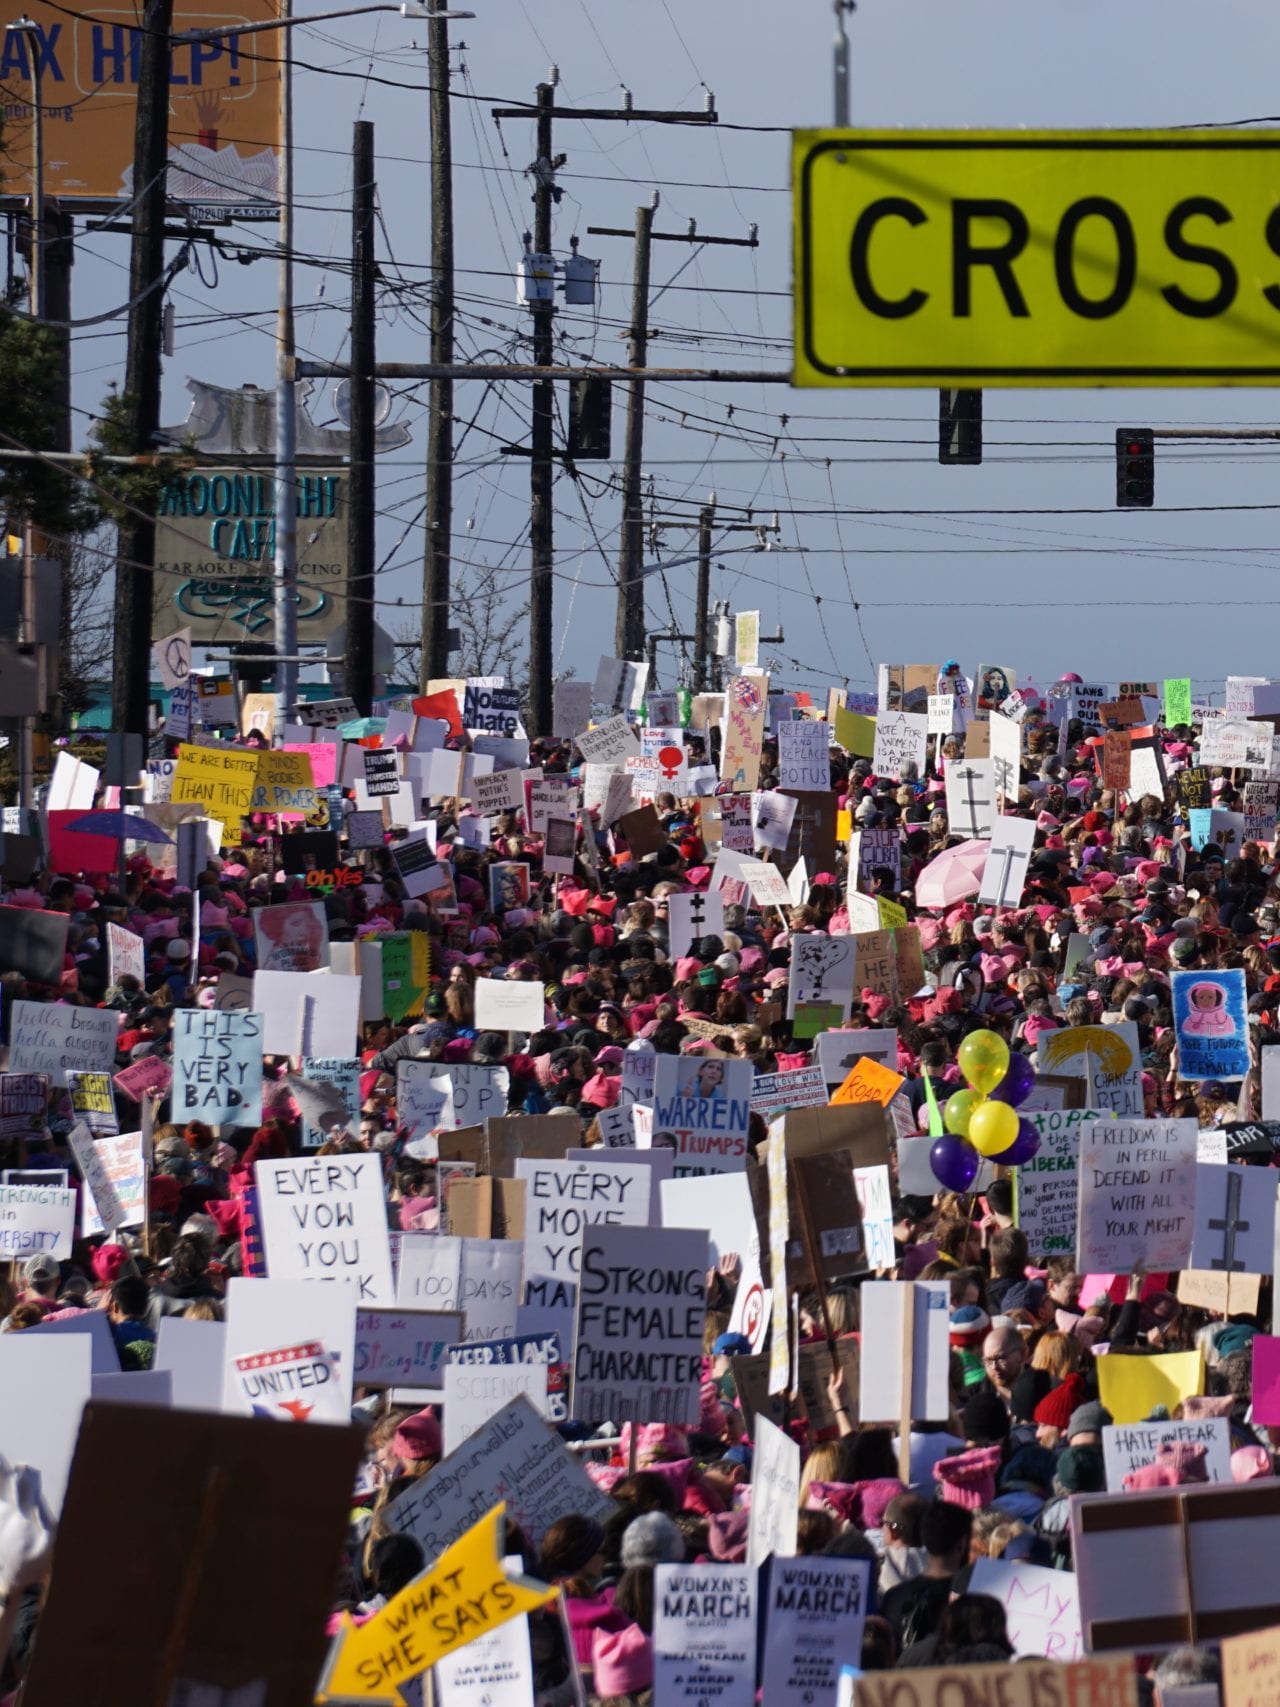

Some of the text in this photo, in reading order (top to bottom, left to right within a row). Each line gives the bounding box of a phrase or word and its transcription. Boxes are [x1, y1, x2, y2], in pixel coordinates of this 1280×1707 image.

[159, 476, 340, 517] MOONLHT
[212, 518, 276, 560] CAF
[1076, 686, 1104, 697] LAWS
[1120, 682, 1150, 693] GIRL
[466, 687, 491, 709] No
[781, 723, 828, 736] REPEAL
[878, 725, 921, 738] VOTE FOR
[783, 748, 827, 760] REPLACE
[883, 739, 917, 749] WOMEN
[182, 753, 256, 773] WE ARE BETTER
[366, 754, 396, 765] TRUMP
[474, 774, 508, 788] IMPEACH
[781, 768, 827, 785] POTUS
[176, 777, 248, 807] THAN THIS
[368, 782, 399, 792] HANDS
[1182, 785, 1202, 796] NOT
[1244, 806, 1266, 815] LOVE
[862, 831, 898, 846] STOP
[1243, 828, 1264, 839] HATE
[857, 937, 880, 952] WE
[181, 1011, 259, 1037] THIS
[198, 1037, 233, 1060] IS
[180, 1059, 249, 1085] VERY
[1188, 1061, 1240, 1075] FEMALE
[846, 1075, 892, 1100] ROAR!
[1094, 1071, 1139, 1089] CHANGE
[3, 1096, 44, 1114] TRUMP
[185, 1084, 250, 1109] BAD.
[654, 1096, 748, 1130] WARREN
[675, 1130, 745, 1156] TRUMPS
[1048, 1133, 1069, 1146] the
[1091, 1127, 1178, 1145] FREEDOM IS
[1055, 1145, 1071, 1155] of
[1117, 1149, 1173, 1164] IN PERIL
[275, 1163, 365, 1195] EVERY
[533, 1171, 633, 1202] EVERY
[1093, 1168, 1176, 1189] DEFEND IT
[1111, 1194, 1173, 1211] WITH ALL
[2, 1209, 16, 1221] in
[292, 1202, 354, 1229] VOW
[1105, 1217, 1185, 1237] YOUR MIGHT
[299, 1239, 359, 1266] YOU
[583, 1247, 705, 1296] STRONG
[415, 1276, 513, 1300] 100 DAYS
[580, 1305, 704, 1338] FEMALE
[511, 1338, 560, 1364] LAWS
[575, 1344, 701, 1384] CHARACTER
[242, 1362, 331, 1398] UNITED
[457, 1375, 532, 1399] SCIENCE
[1114, 1423, 1217, 1452] HATE and FEAR
[669, 1577, 748, 1593] WOMXN'S
[783, 1569, 860, 1589] WOMXN'S
[385, 1567, 464, 1634] WHAT
[664, 1595, 750, 1618] MARCH
[777, 1587, 860, 1615] MARCH
[357, 1580, 516, 1690] SHE SAYS
